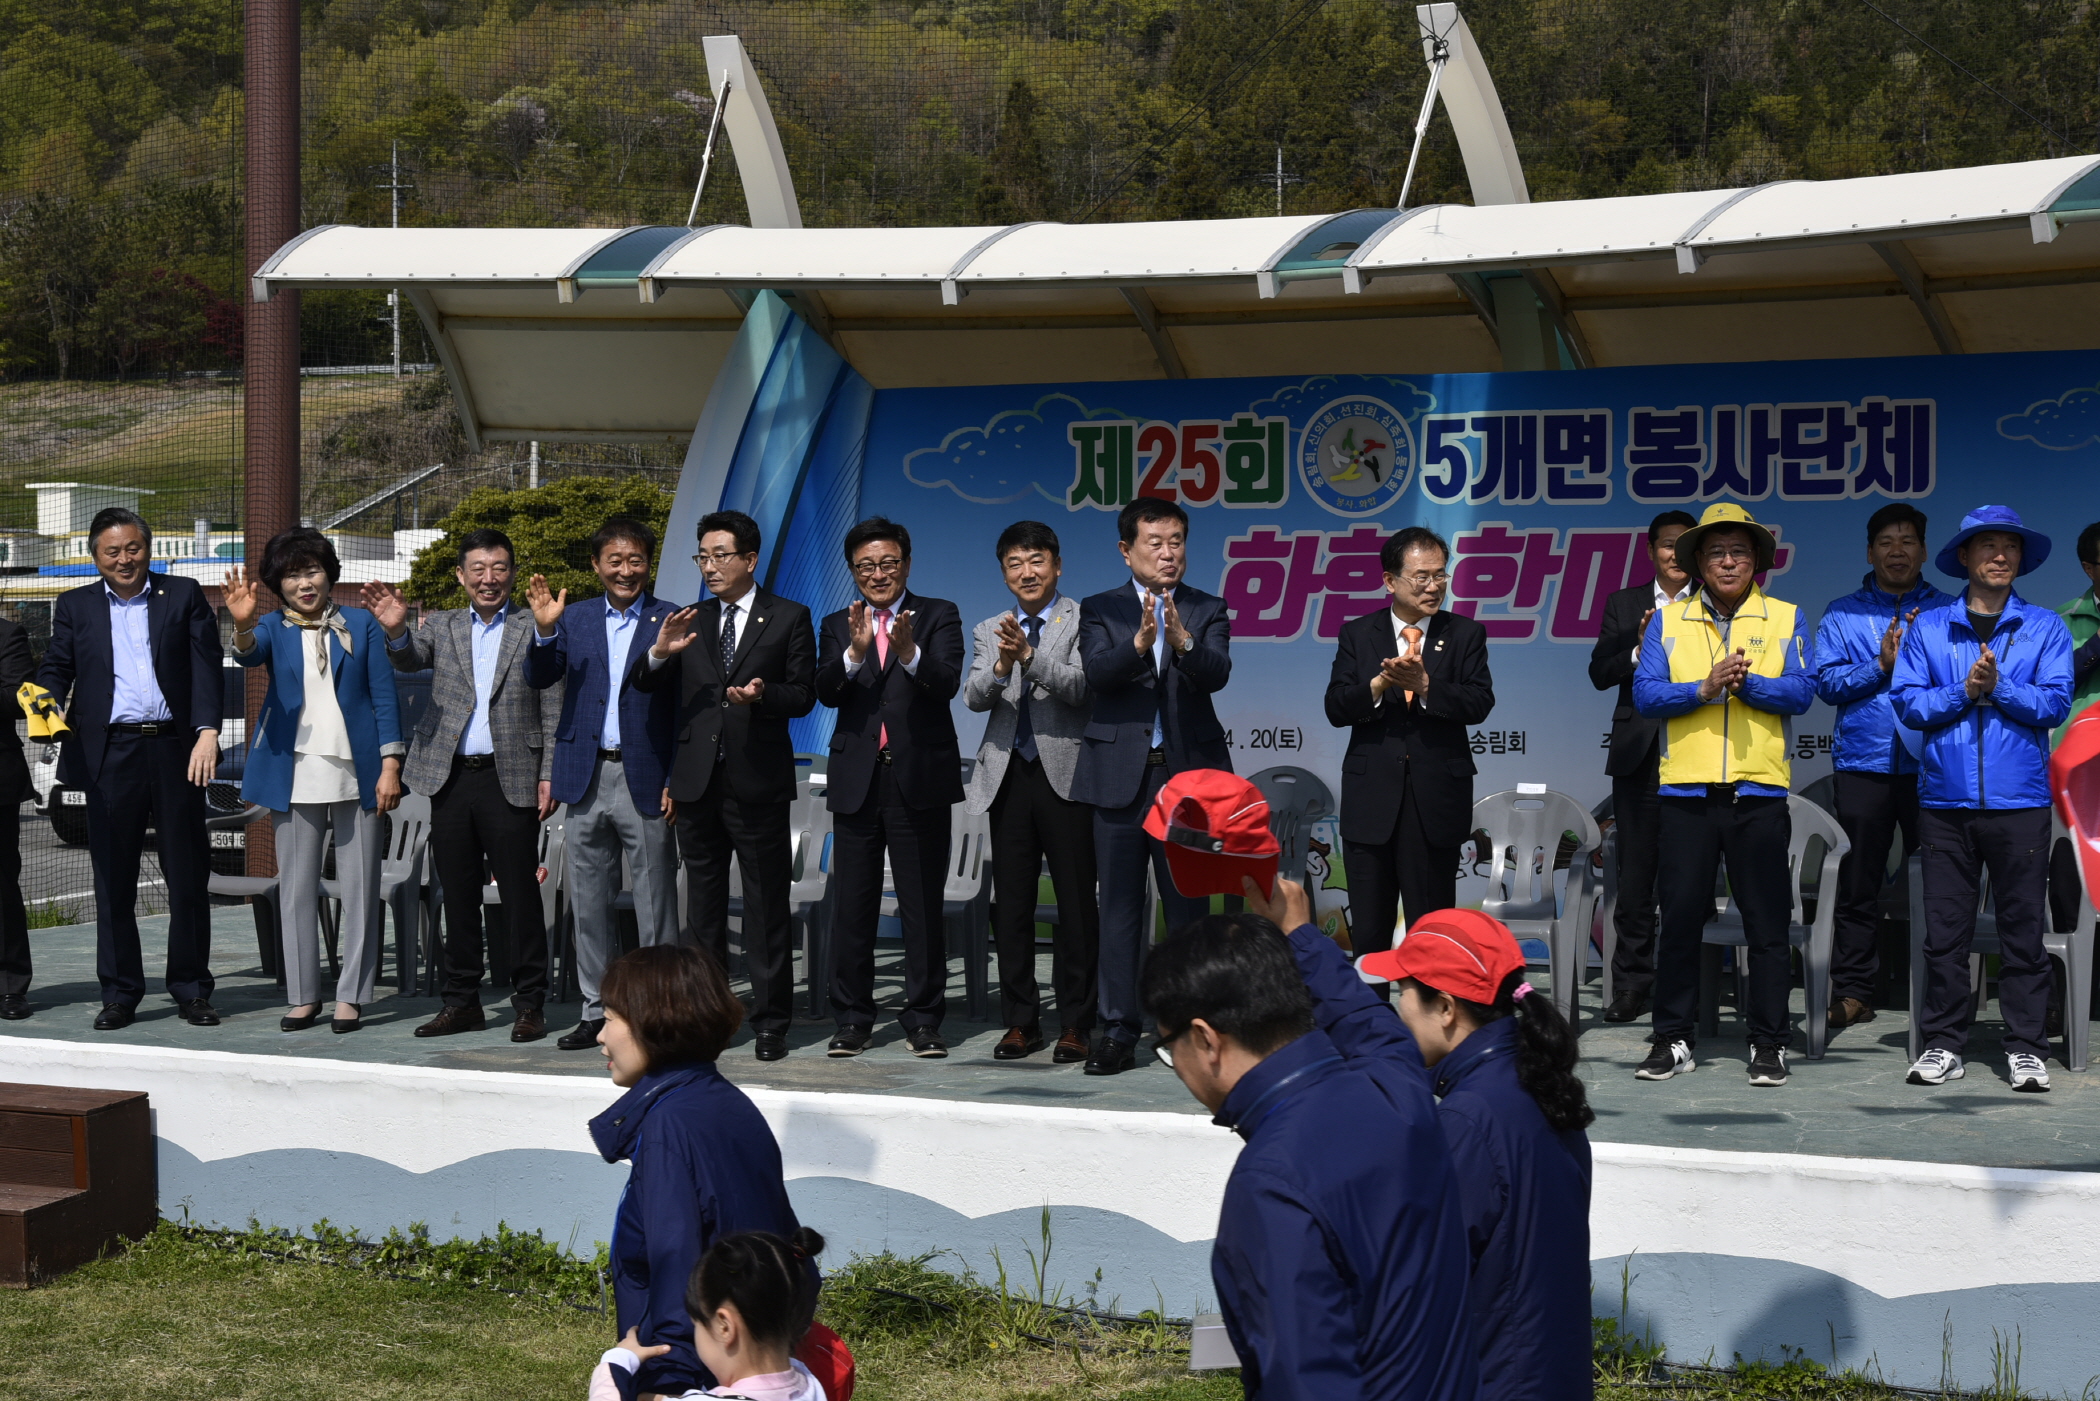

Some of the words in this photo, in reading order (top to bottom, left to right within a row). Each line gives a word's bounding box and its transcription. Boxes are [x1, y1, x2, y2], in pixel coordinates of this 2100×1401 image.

[1068, 415, 1286, 509] 제25회
[1421, 411, 1610, 503] 5개면
[1627, 399, 1933, 501] 봉사단체
[1250, 726, 1303, 752] 20(토)
[1469, 730, 1526, 755] 송림회
